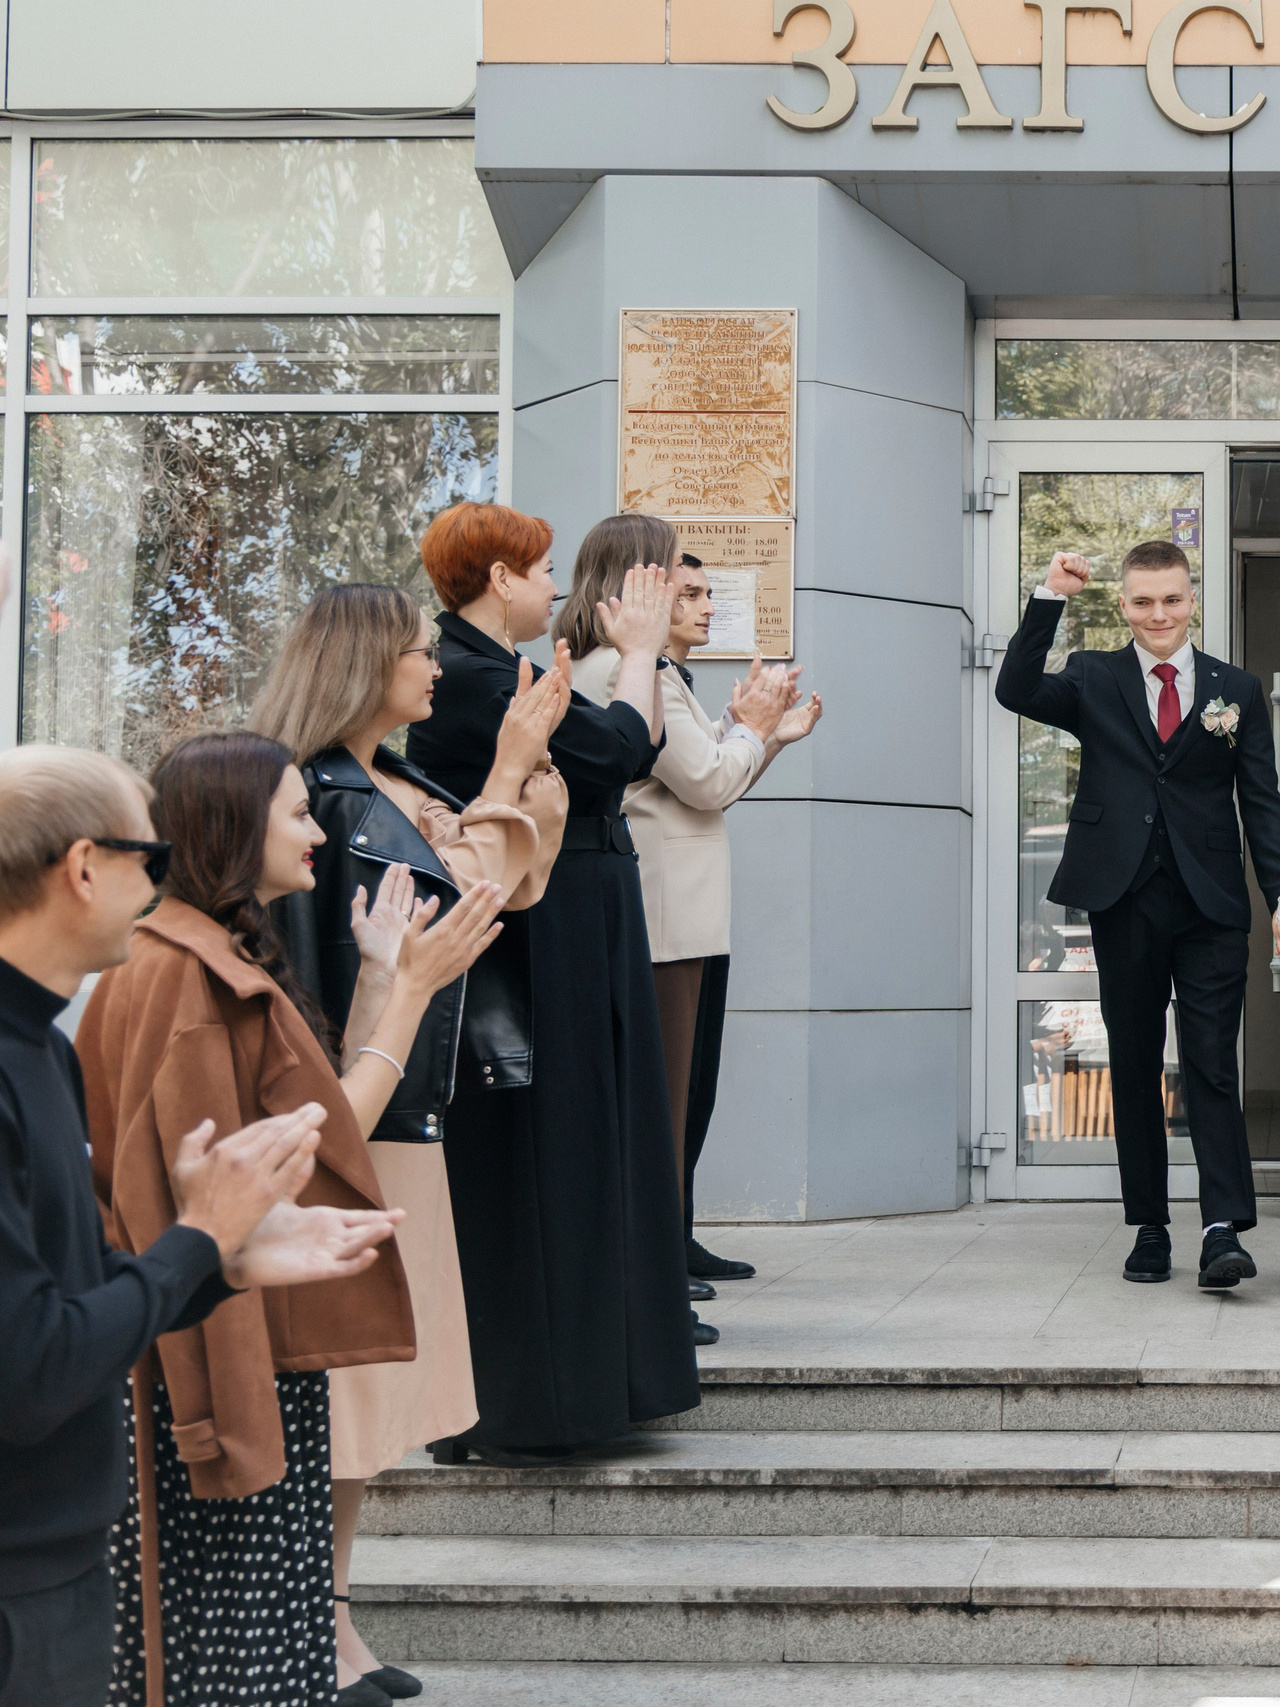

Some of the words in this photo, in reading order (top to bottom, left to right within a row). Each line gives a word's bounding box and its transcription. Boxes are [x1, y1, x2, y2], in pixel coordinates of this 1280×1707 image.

[766, 0, 1267, 134] ЗАГС
[674, 481, 739, 490] Советского
[726, 538, 746, 546] 9.00
[755, 538, 778, 546] 18.00
[722, 549, 746, 557] 13.00
[755, 549, 778, 557] 14.00
[758, 606, 782, 614] 18.00
[759, 617, 783, 625] 14.00
